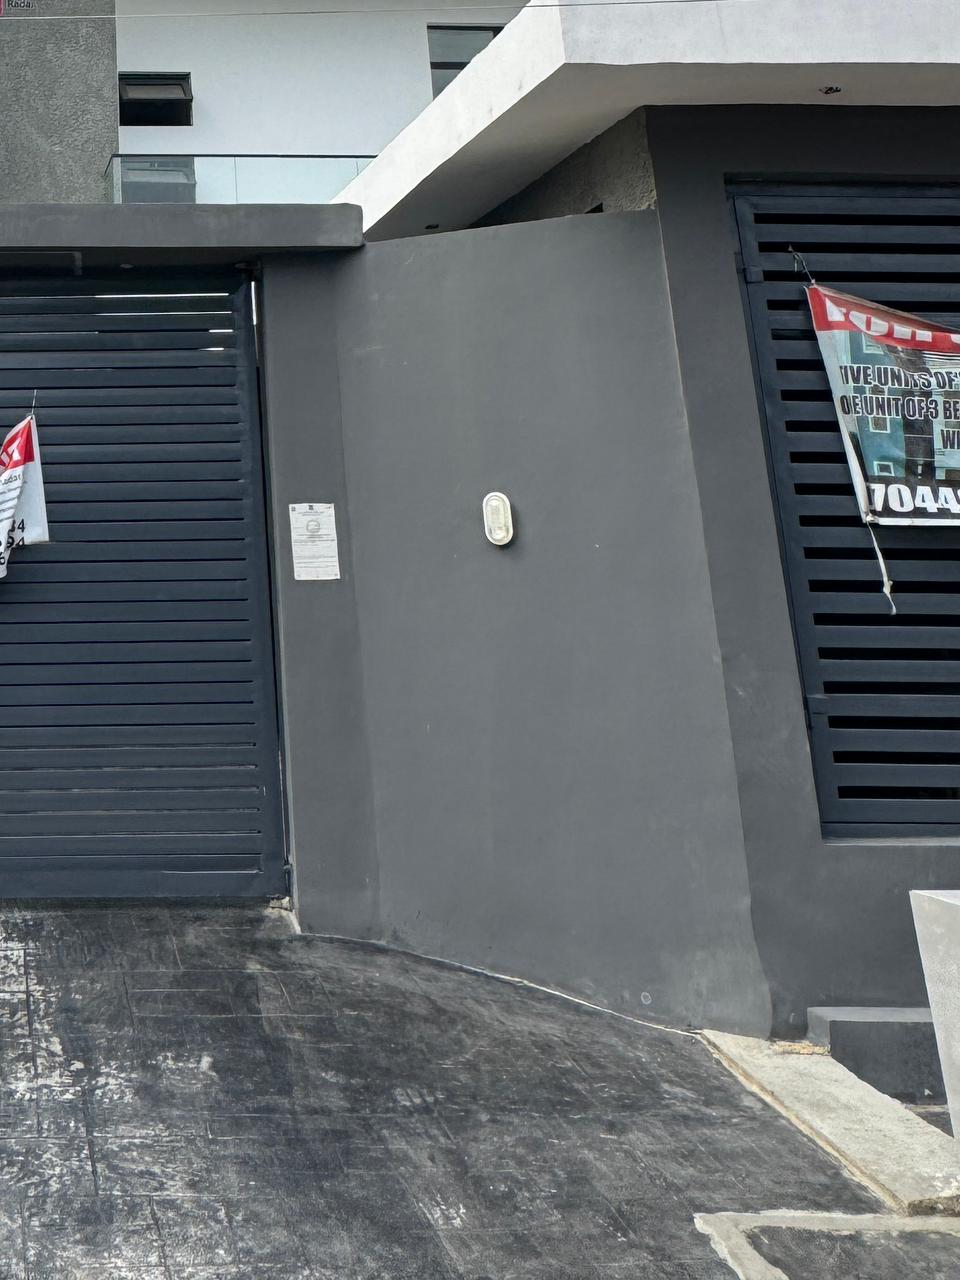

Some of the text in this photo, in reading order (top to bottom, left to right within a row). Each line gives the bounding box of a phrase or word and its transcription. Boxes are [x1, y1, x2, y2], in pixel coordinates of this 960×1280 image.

[863, 396, 902, 418] UNIT
[904, 397, 926, 419] OF
[928, 398, 939, 420] 3
[869, 483, 960, 514] 7044
